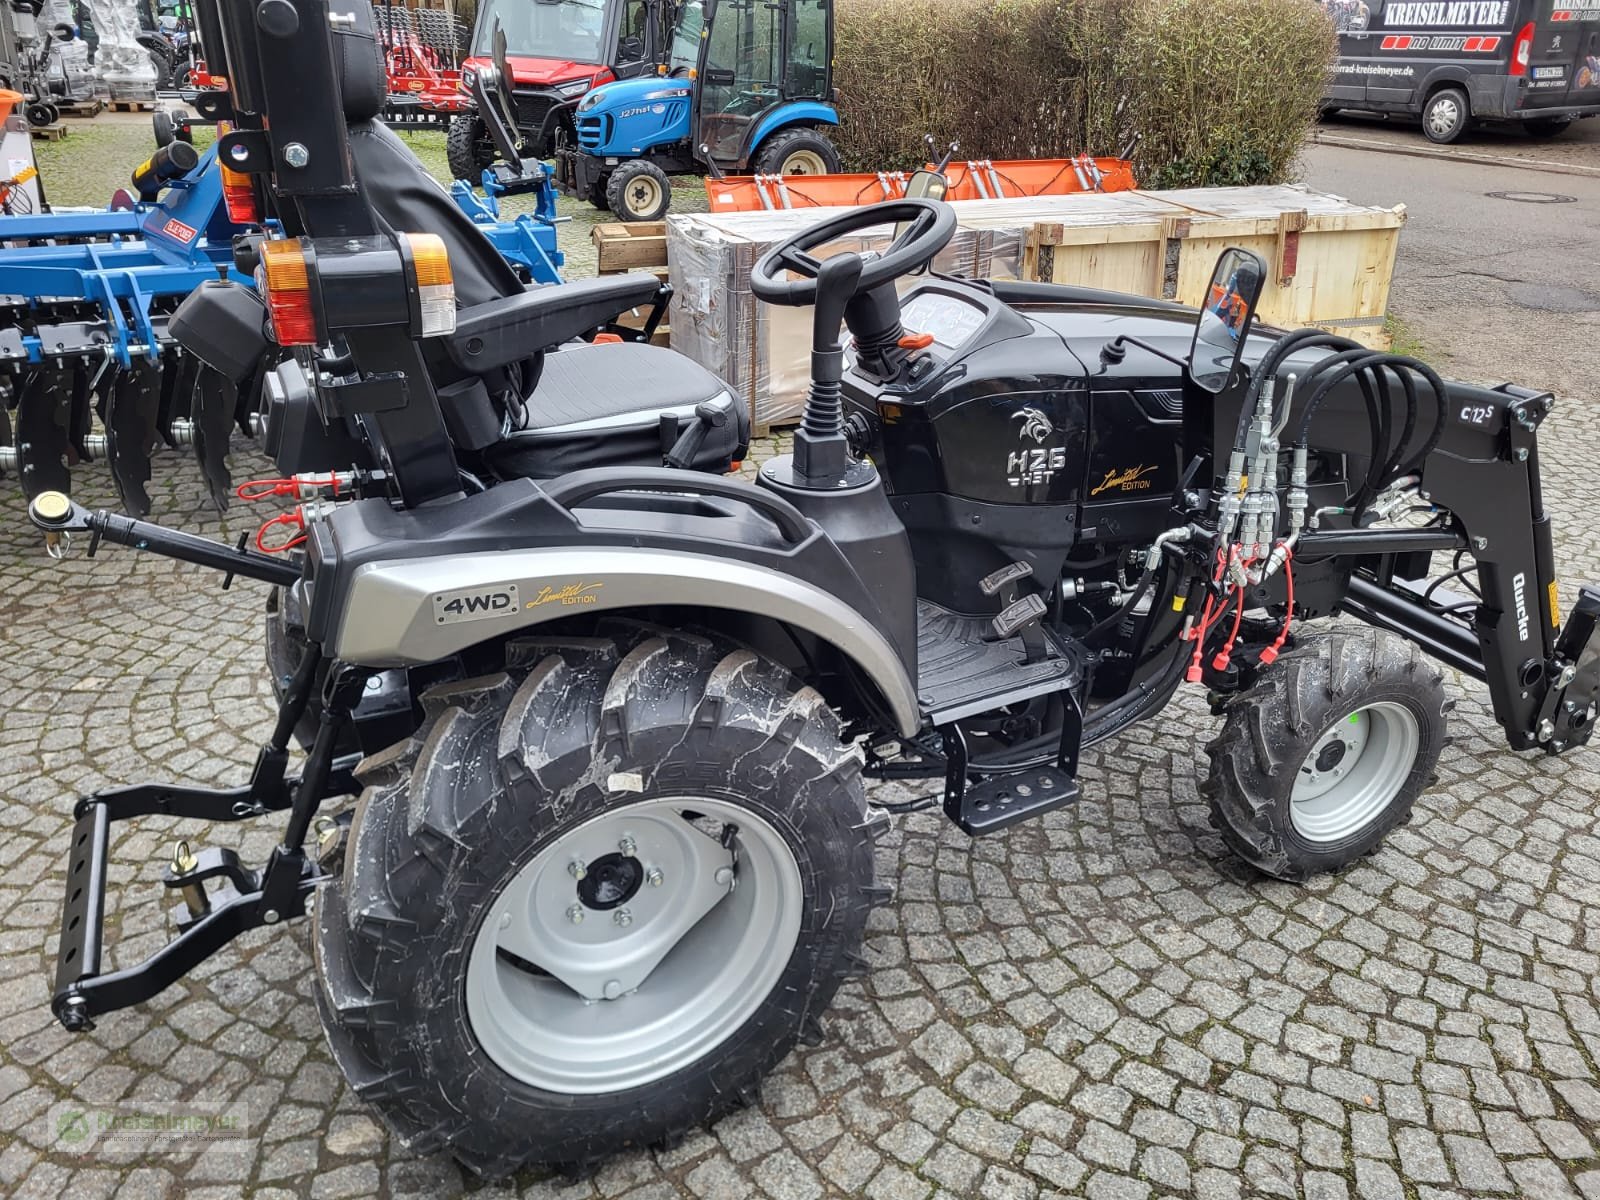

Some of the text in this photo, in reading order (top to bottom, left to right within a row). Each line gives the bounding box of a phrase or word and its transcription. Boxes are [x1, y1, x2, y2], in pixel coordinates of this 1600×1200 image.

[1384, 2, 1501, 25] KREISELMEYER
[1091, 464, 1159, 496] Limited
[1121, 480, 1151, 491] EDITION
[443, 593, 511, 615] 4WD
[526, 582, 603, 609] Limited
[561, 595, 597, 605] EDITION
[1512, 572, 1529, 642] Quicke
